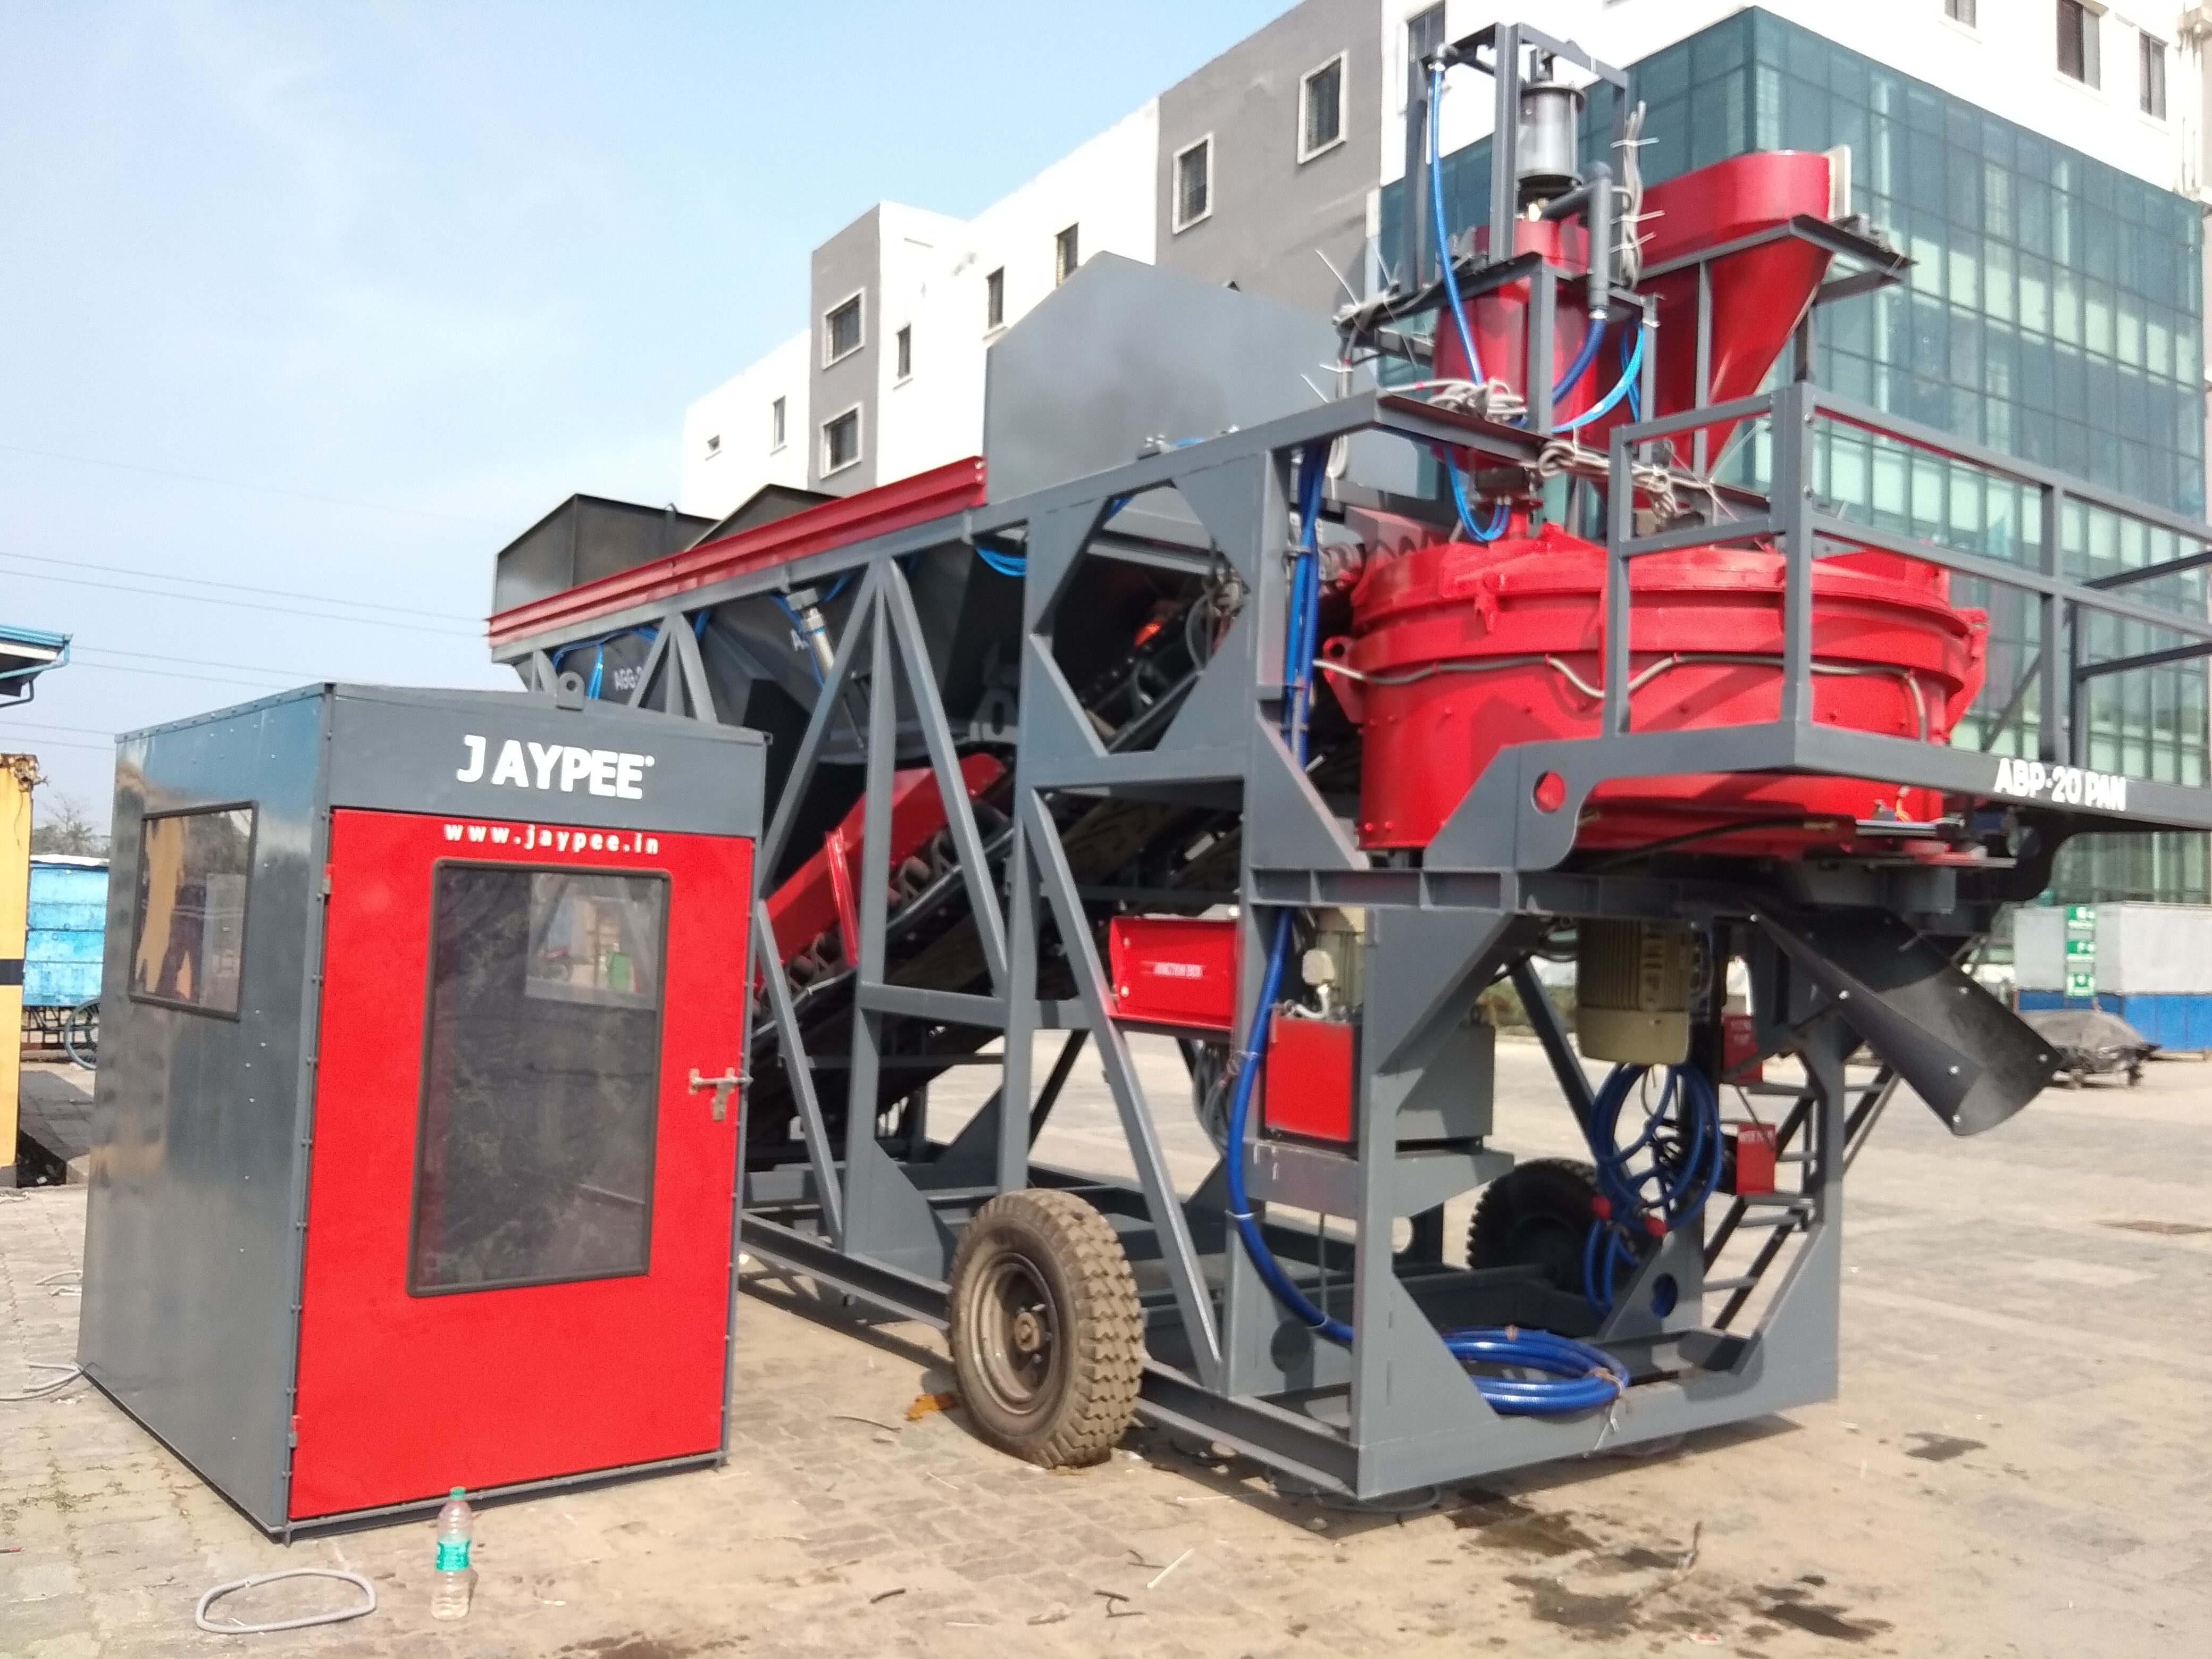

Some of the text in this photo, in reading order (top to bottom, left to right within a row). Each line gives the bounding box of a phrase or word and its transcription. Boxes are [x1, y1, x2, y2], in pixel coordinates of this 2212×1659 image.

[1994, 758, 2126, 811] ABP-20 PAN
[443, 823, 659, 854] www.jaypee.in
